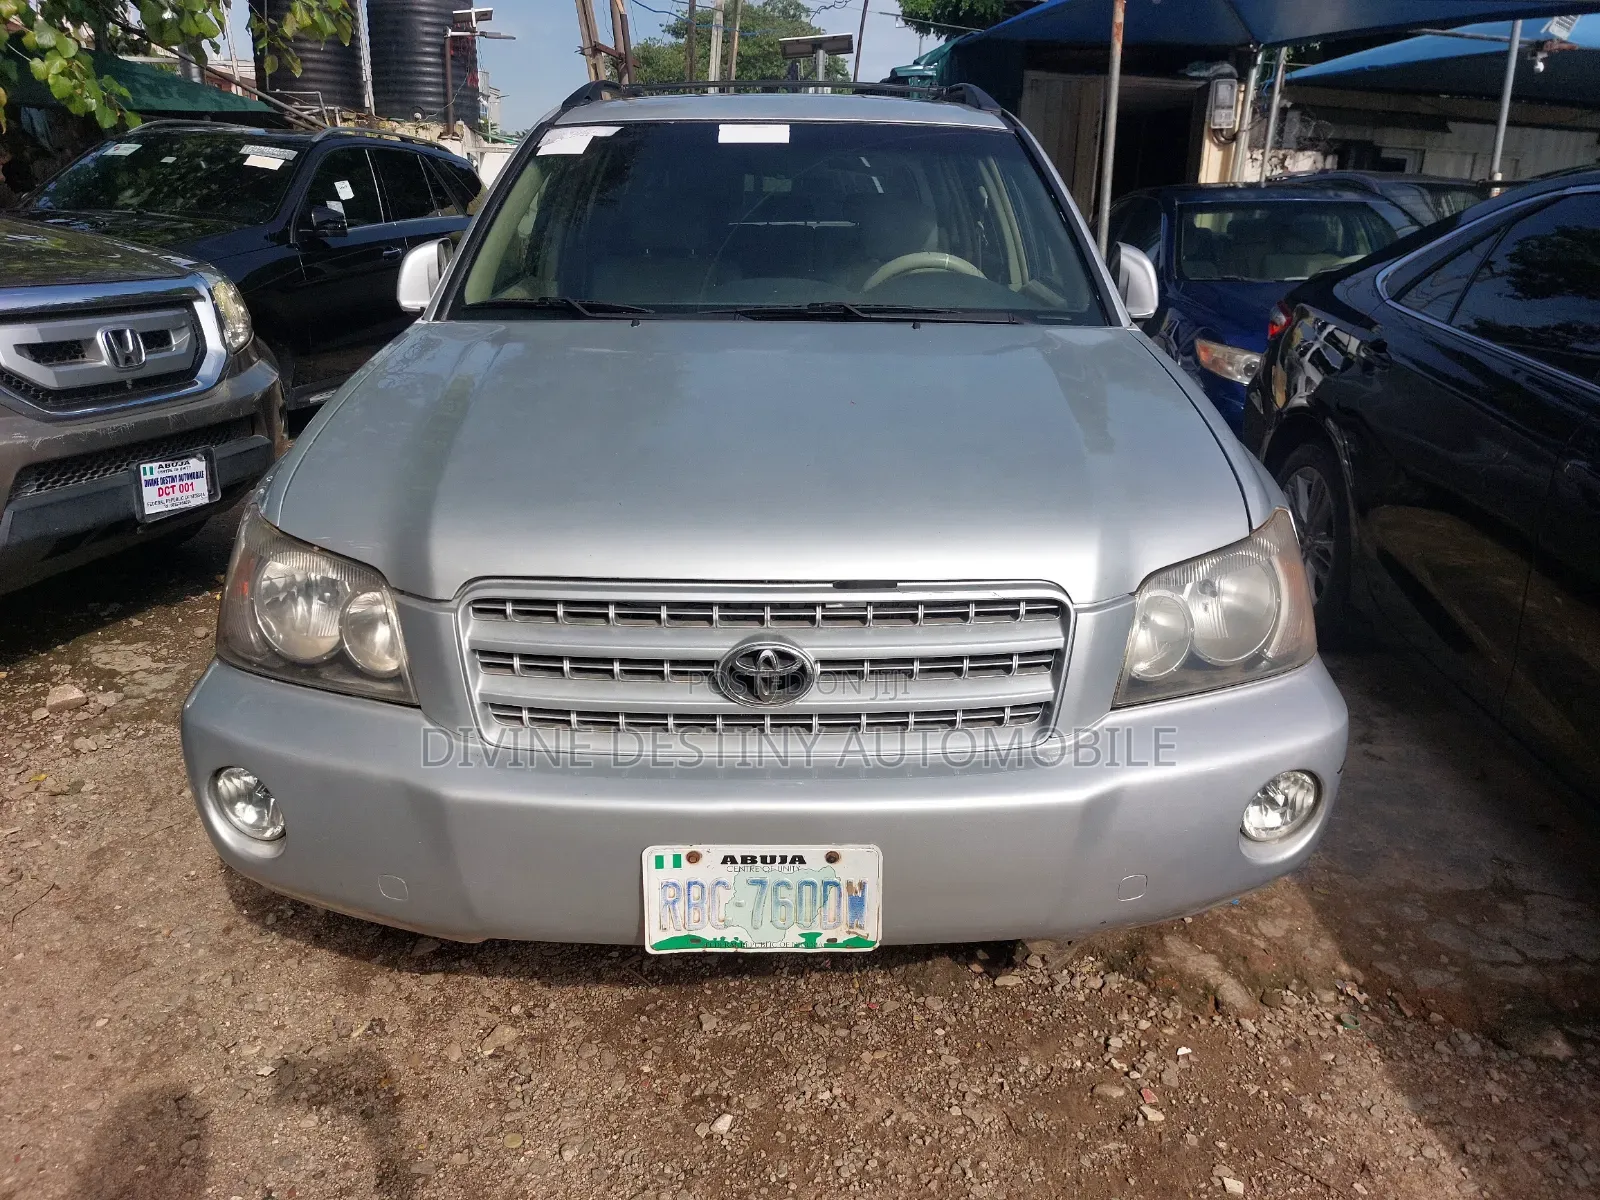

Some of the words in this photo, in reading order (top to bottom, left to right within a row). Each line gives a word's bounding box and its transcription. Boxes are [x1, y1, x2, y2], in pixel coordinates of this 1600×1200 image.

[158, 460, 190, 469] ABUJA
[144, 478, 159, 487] DIVINE
[160, 475, 178, 485] DESTINY
[178, 471, 204, 482] AUTOMOBILE
[158, 485, 176, 497] DCT
[179, 482, 194, 493] 001
[720, 854, 807, 865] ABUJA
[726, 865, 760, 873] CENTRE
[762, 865, 775, 873] OF
[777, 864, 801, 873] UNITY
